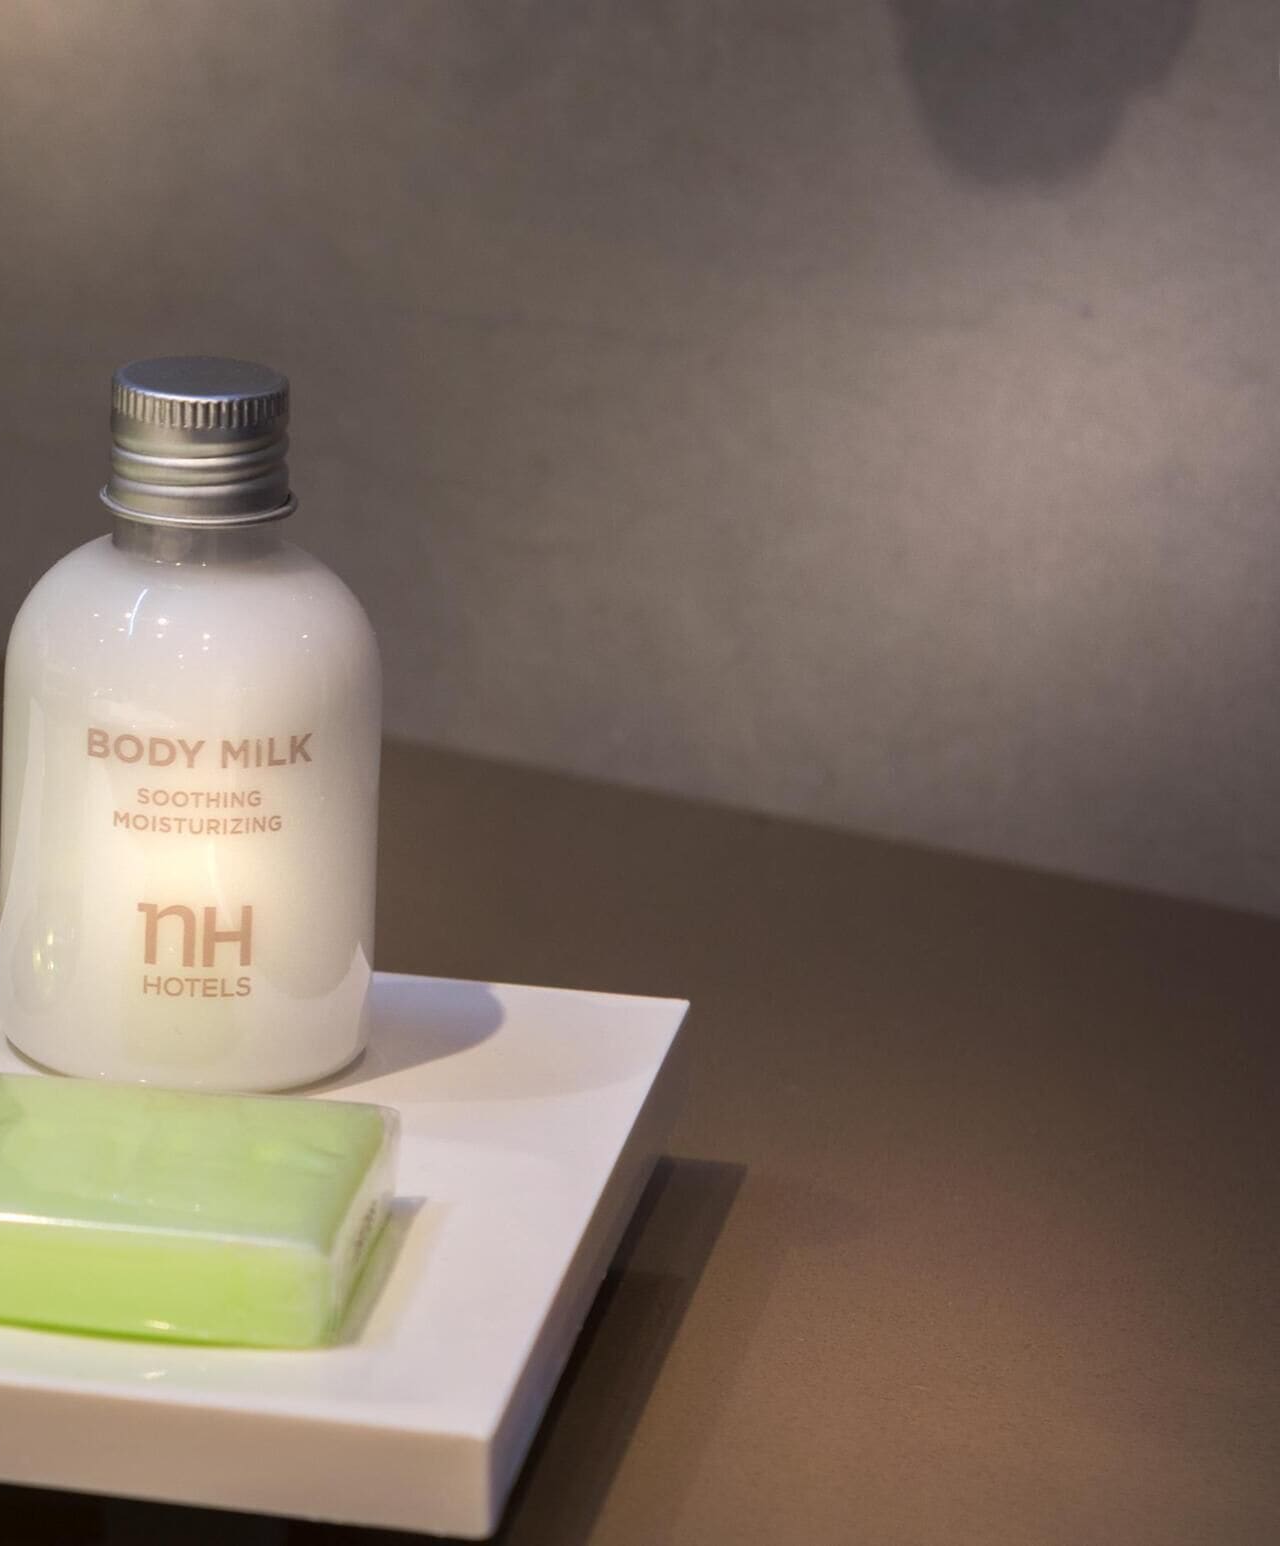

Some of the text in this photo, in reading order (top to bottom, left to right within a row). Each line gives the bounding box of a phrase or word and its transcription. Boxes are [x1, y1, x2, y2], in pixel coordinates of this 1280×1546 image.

[87, 728, 313, 769] BODY MILK
[137, 788, 262, 809] SOOTHING
[113, 810, 282, 836] MOISTURIZING
[143, 975, 251, 998] HOTELS
